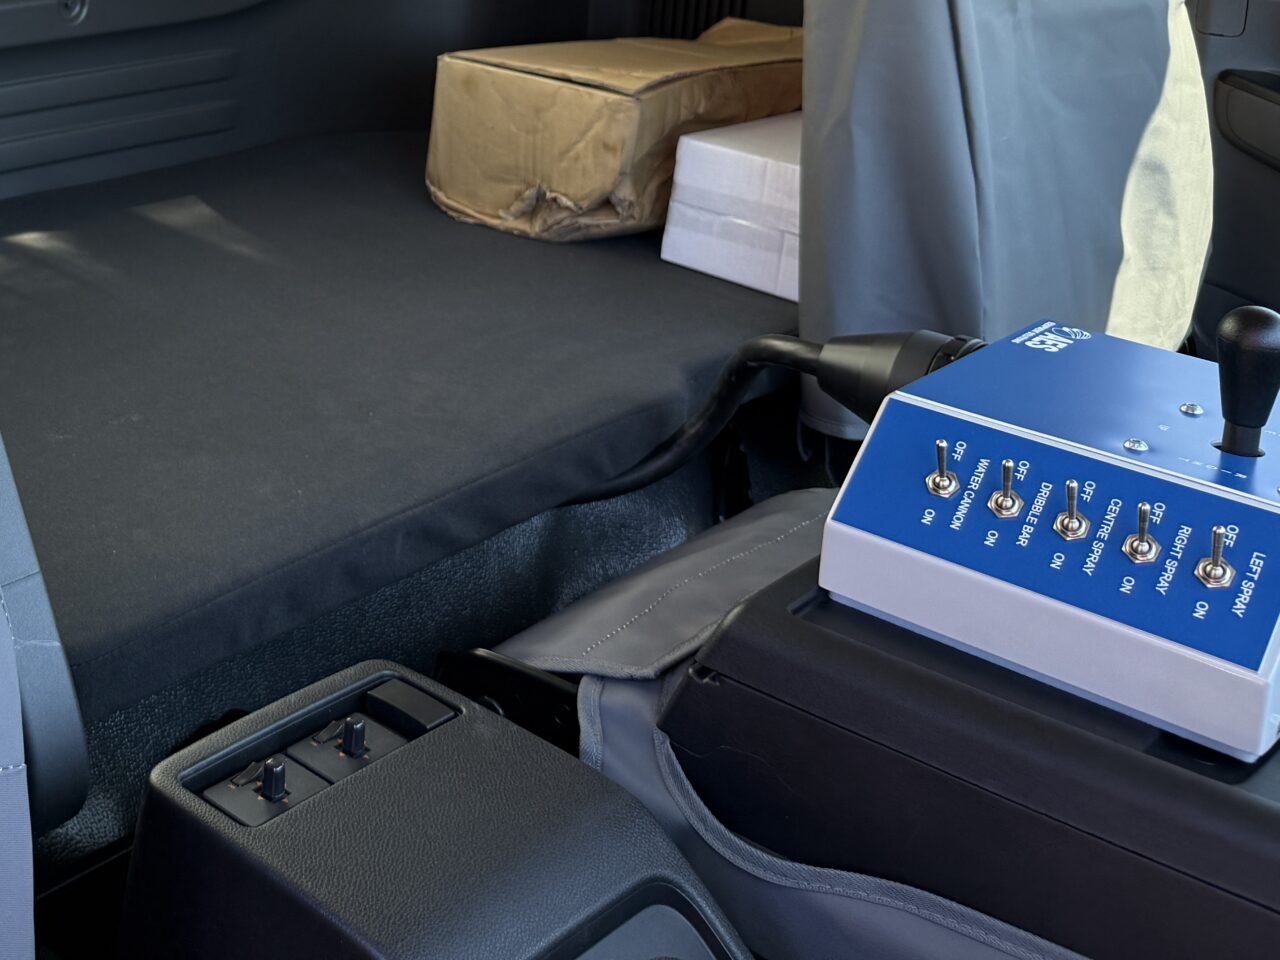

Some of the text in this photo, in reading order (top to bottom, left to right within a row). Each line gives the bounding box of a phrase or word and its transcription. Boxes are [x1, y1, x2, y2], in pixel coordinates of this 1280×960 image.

[1024, 331, 1075, 353] AES
[951, 441, 967, 461] OFF
[1014, 460, 1030, 481] OFF
[949, 458, 991, 531] WATER CANNON
[1080, 480, 1096, 503] OFF
[920, 508, 936, 525] ON
[1015, 481, 1053, 547] DRIBBLE BAR
[1149, 502, 1166, 524] OFF
[983, 530, 999, 547] ON
[1082, 498, 1122, 576] CENTRE SPRAY
[1223, 524, 1239, 548] OFF
[1049, 552, 1065, 570] ON
[1155, 524, 1193, 596] RIGHT SPRAY
[1119, 576, 1136, 594] ON
[1231, 551, 1267, 618] LEFT SPRAY
[1192, 601, 1209, 619] ON
